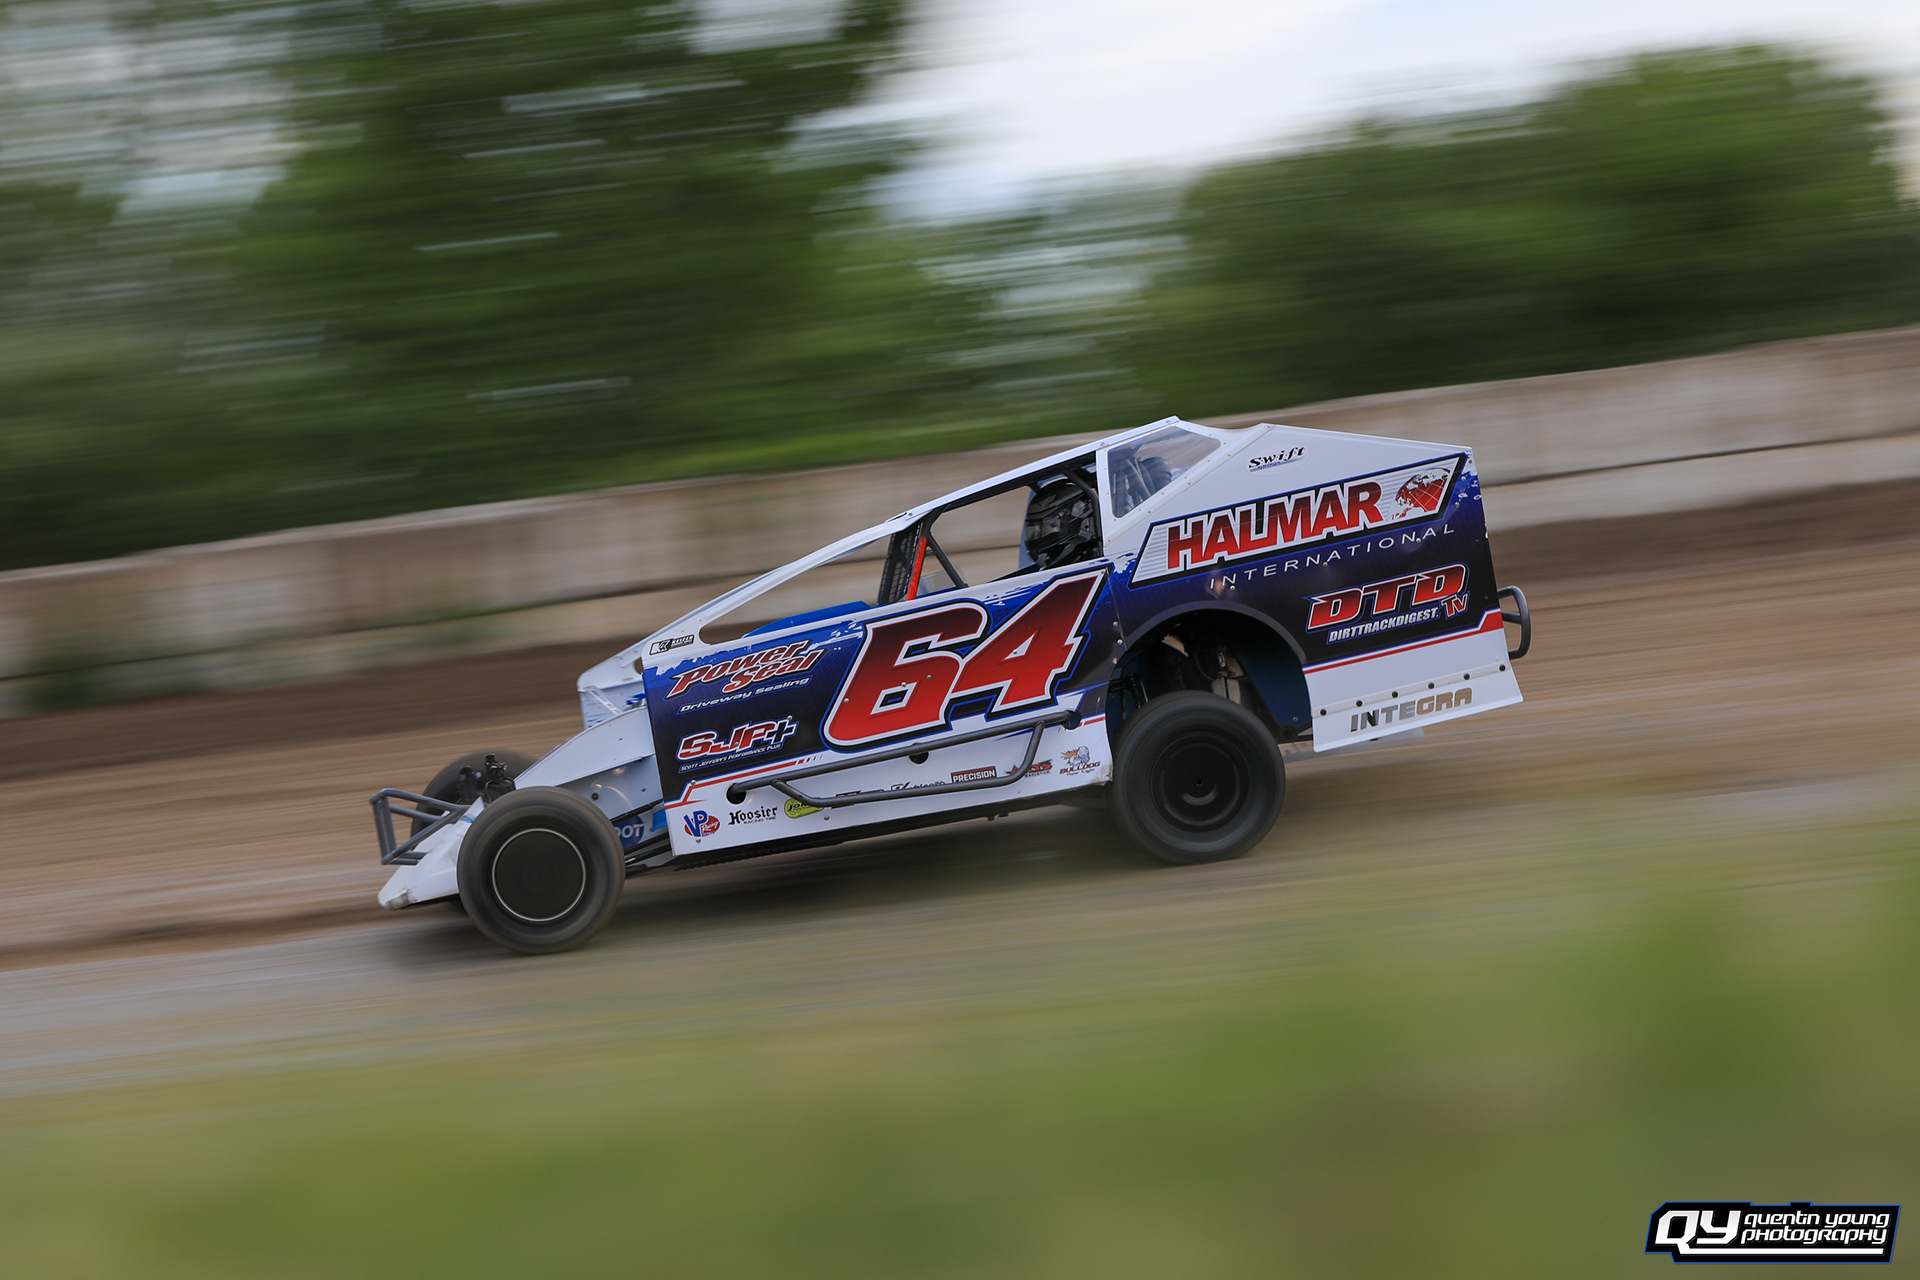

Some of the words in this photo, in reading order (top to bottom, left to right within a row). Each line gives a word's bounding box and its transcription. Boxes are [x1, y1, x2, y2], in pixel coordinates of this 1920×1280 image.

[1249, 447, 1304, 468] Swift
[1165, 481, 1387, 572] HALMAR
[1210, 526, 1455, 589] INTERNATIONAL
[1304, 564, 1467, 630] DTD
[666, 639, 812, 699] Power
[722, 649, 826, 694] Seal
[823, 568, 1108, 747] 64
[680, 689, 752, 713] Driveway
[754, 676, 810, 697] Sealing
[1350, 687, 1473, 732] INTEGRA
[952, 769, 996, 783] PRECISION
[1059, 761, 1101, 775] BULLDOG
[683, 810, 708, 837] VP
[728, 806, 778, 825] Hoosier
